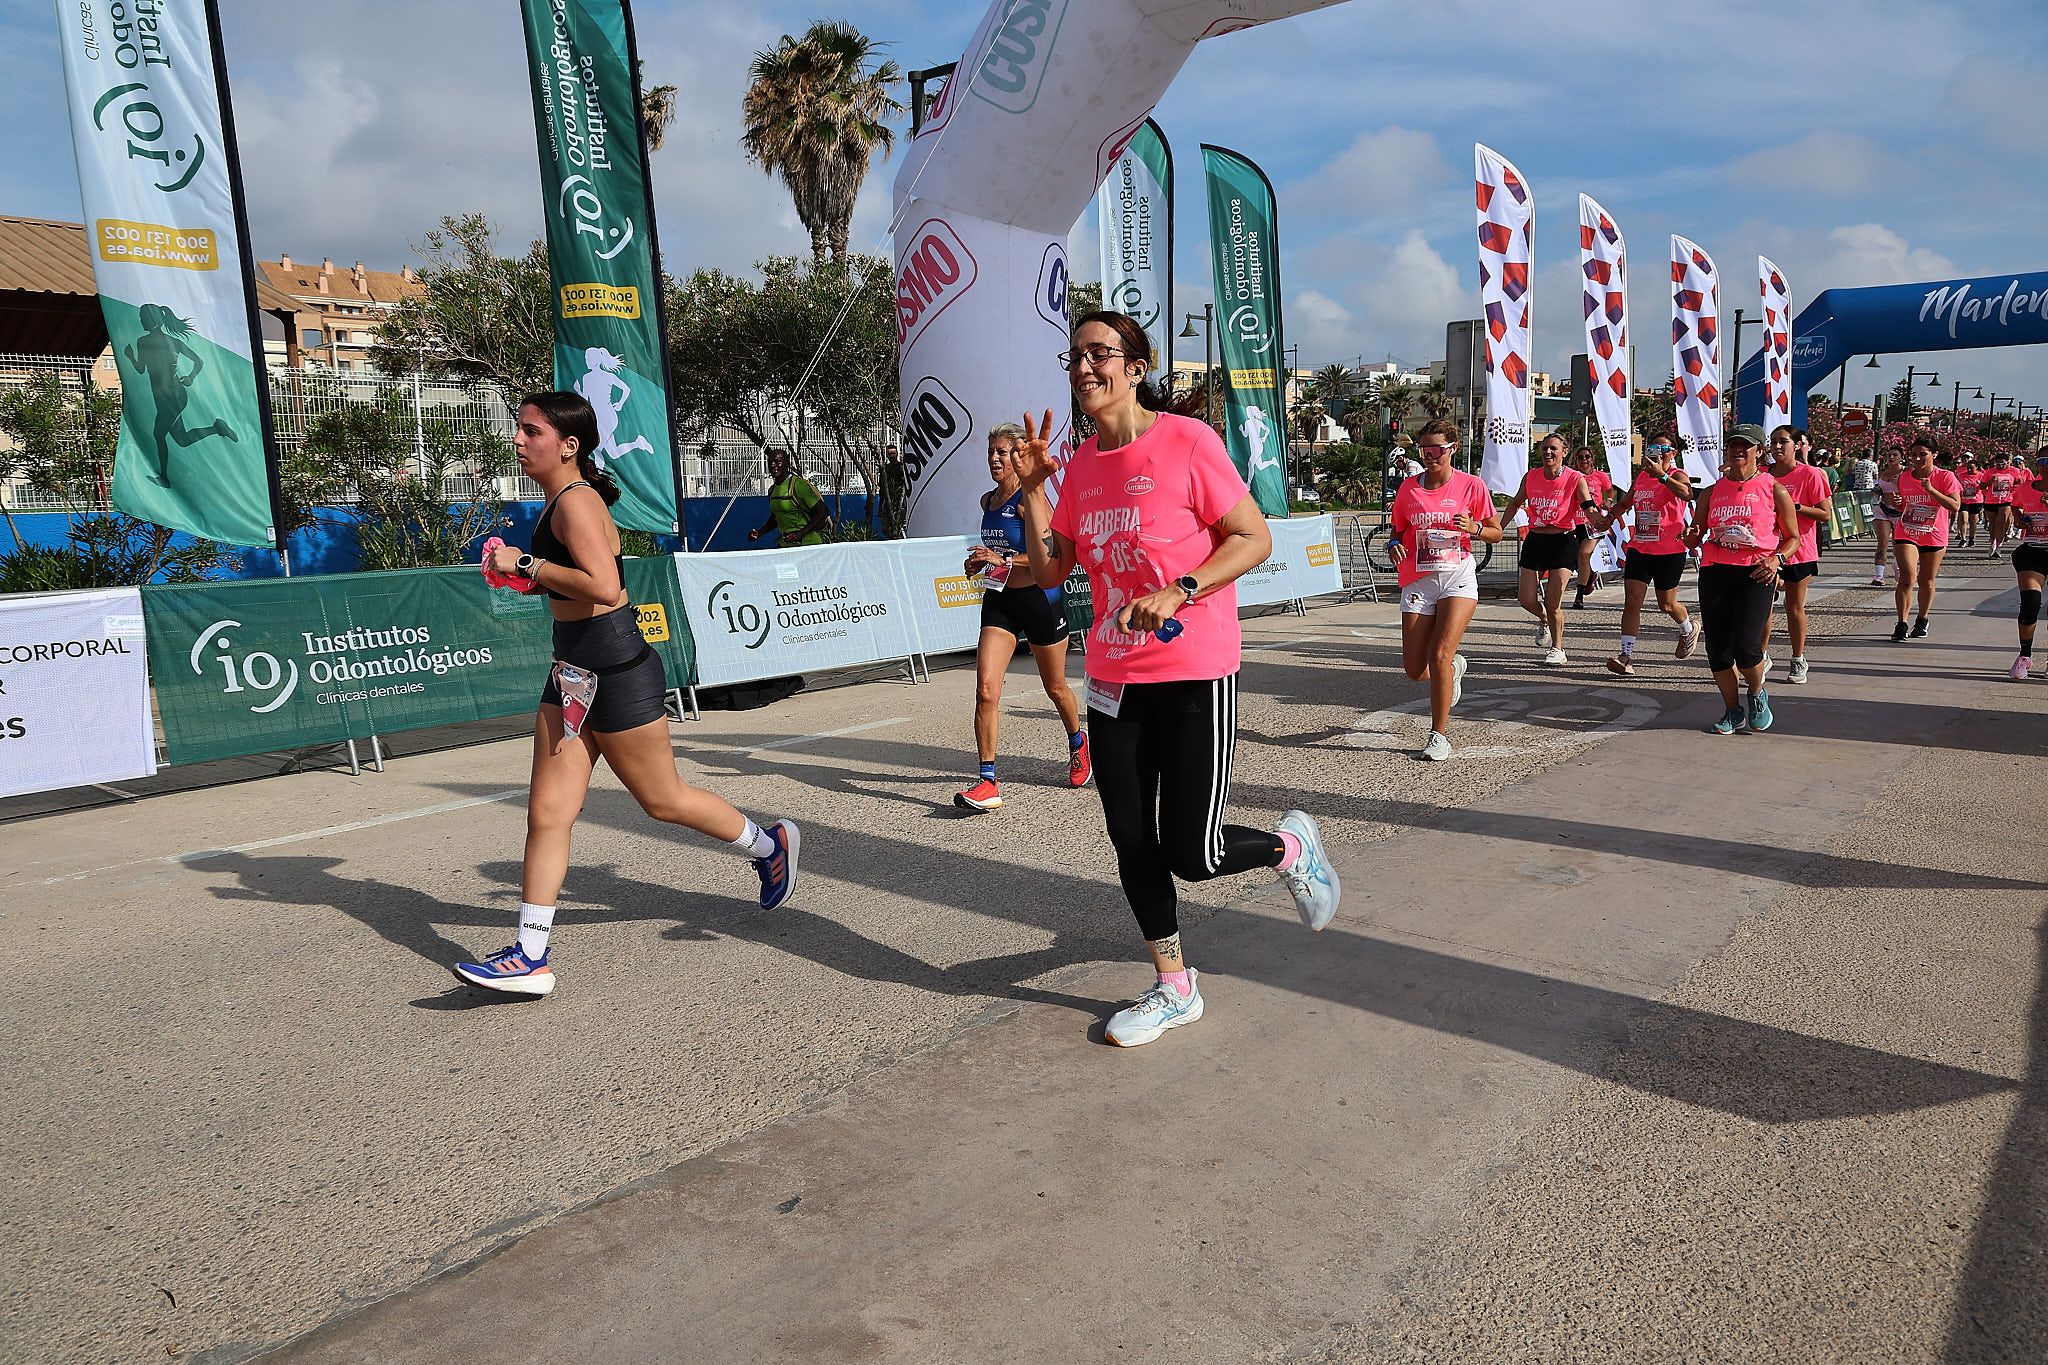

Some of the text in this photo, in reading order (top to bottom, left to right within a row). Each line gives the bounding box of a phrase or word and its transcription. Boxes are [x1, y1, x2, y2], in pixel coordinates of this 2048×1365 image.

[979, 0, 1051, 93] COS
[1410, 511, 1451, 526] CARRERA
[1710, 505, 1752, 518] CARRERA
[771, 584, 848, 608] Institutos
[938, 579, 985, 593] 900 131 00
[777, 601, 887, 630] Odontológicos
[301, 624, 431, 656] Institutos
[782, 628, 848, 645] Clínicas dentales
[309, 646, 493, 685] Odontológicos
[316, 681, 425, 705] Clínicas dentales
